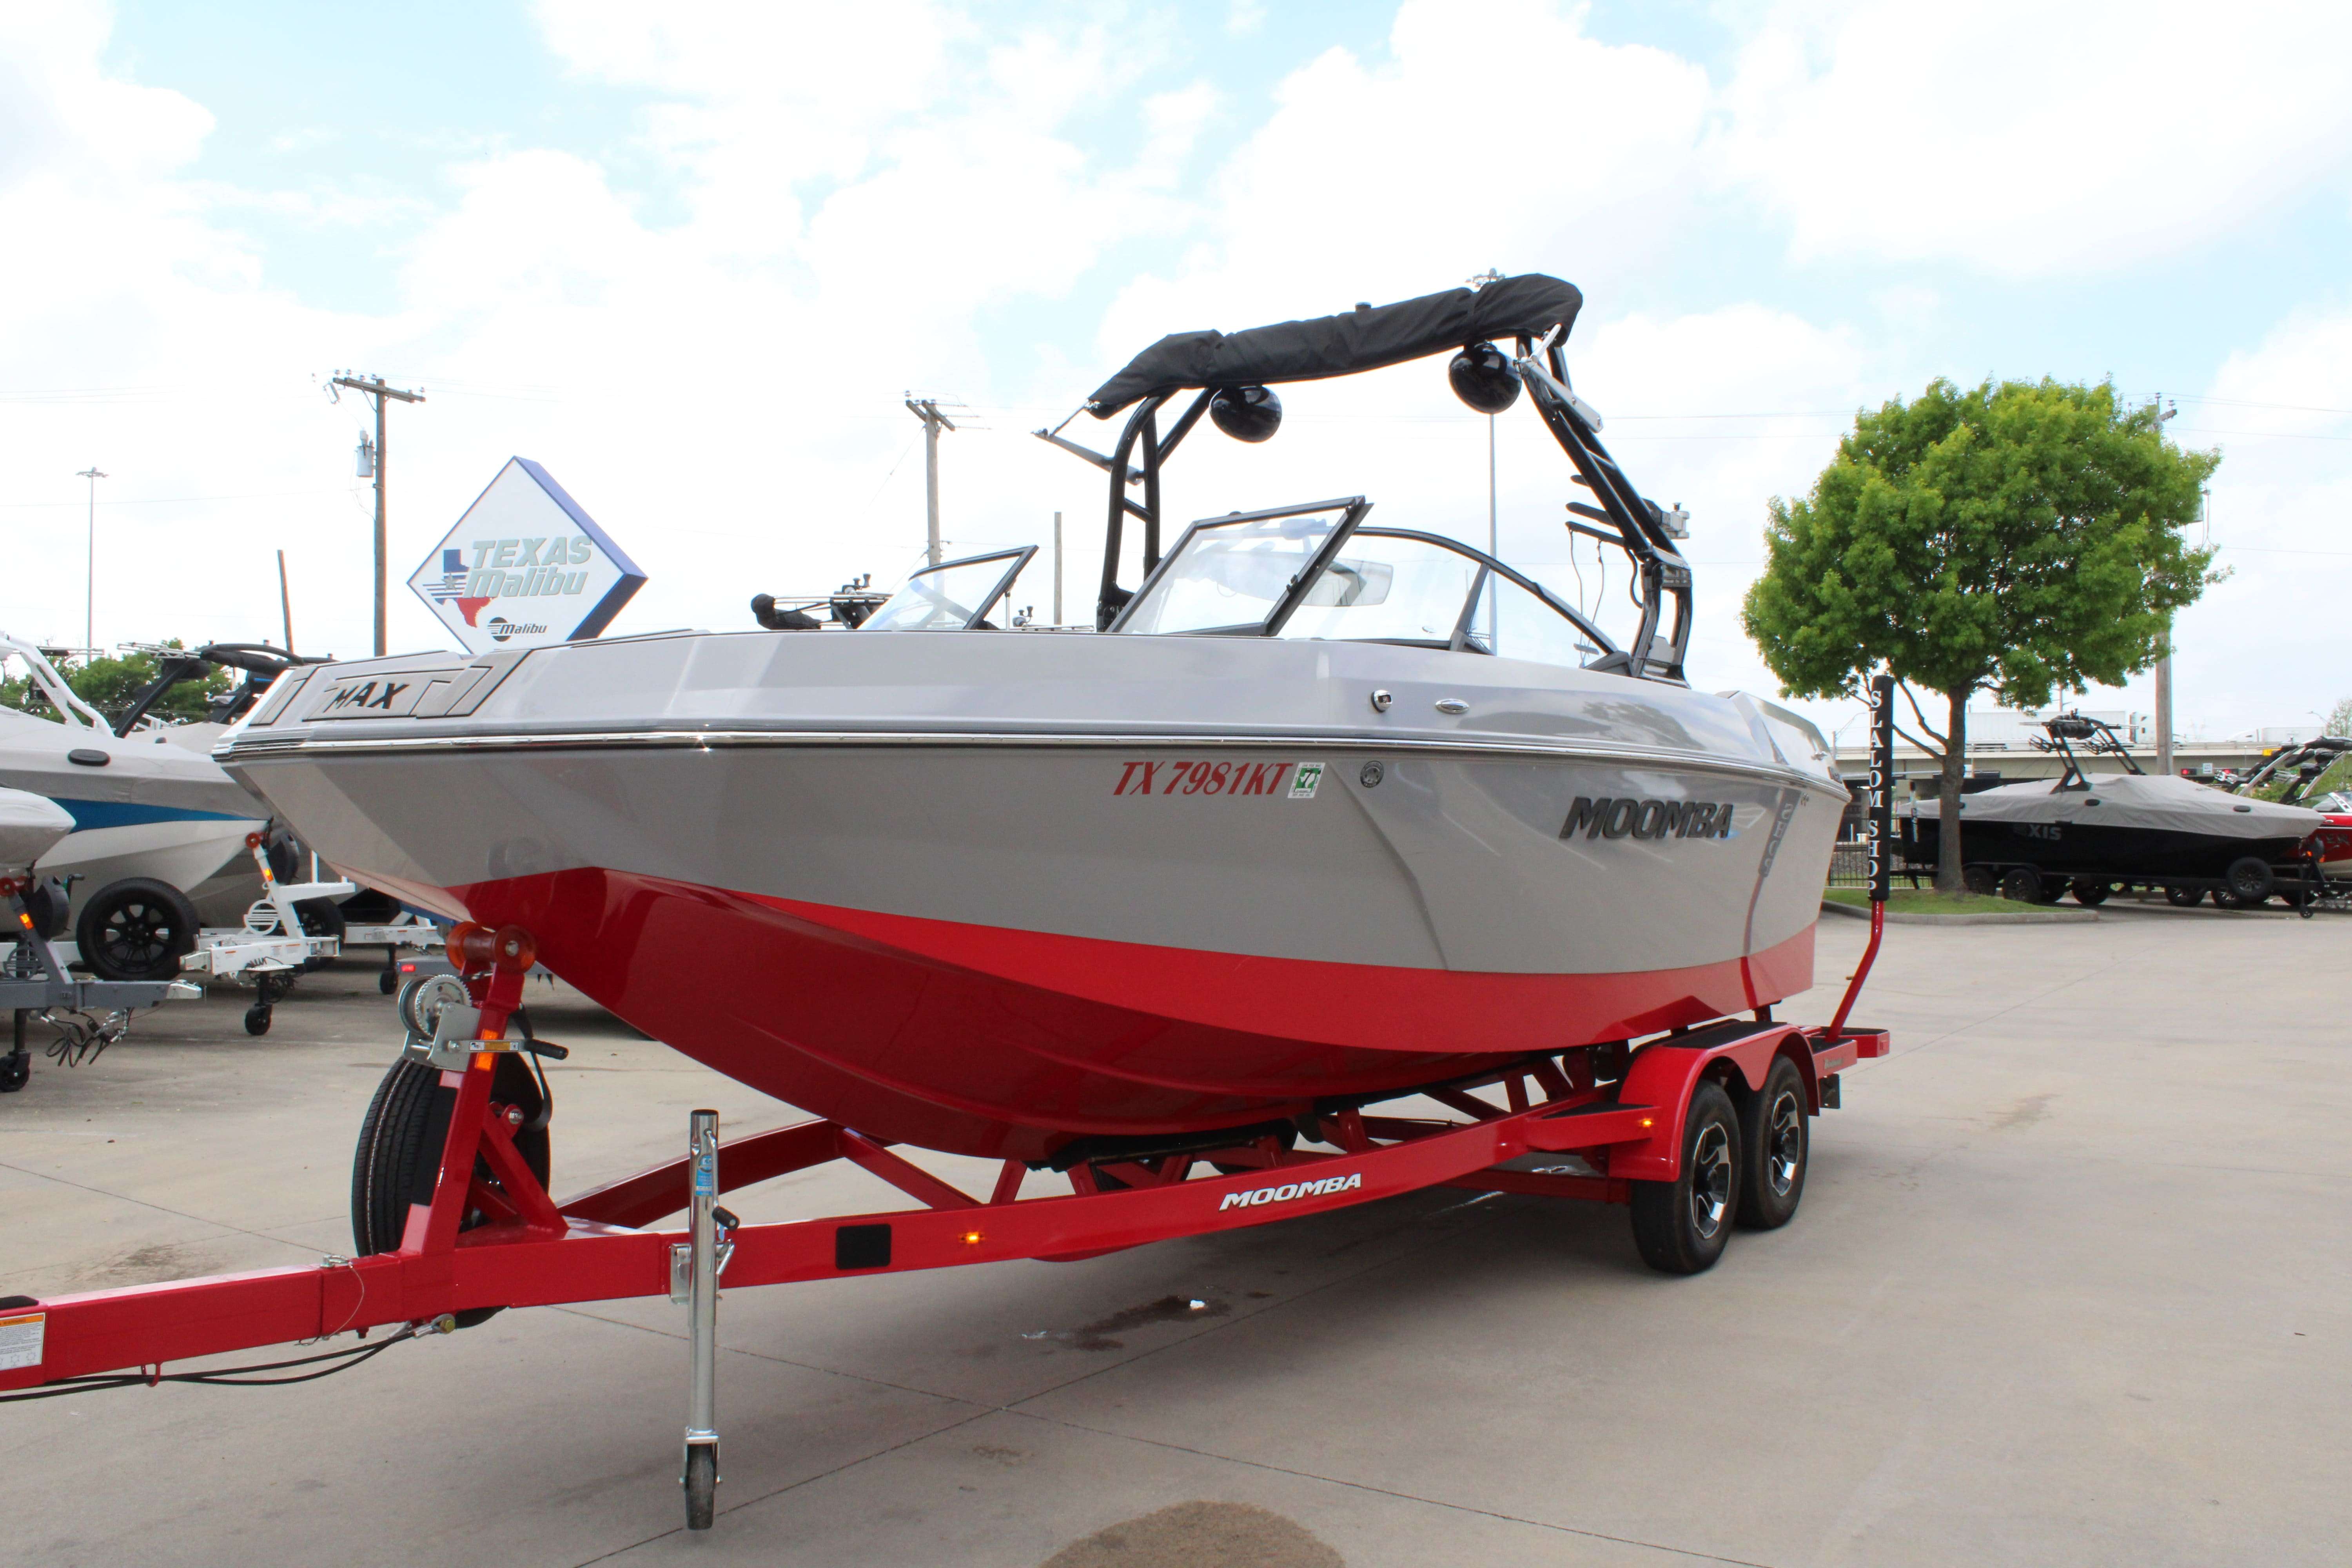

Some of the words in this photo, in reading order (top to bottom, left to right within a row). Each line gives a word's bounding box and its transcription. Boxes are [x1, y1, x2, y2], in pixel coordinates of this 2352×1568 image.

[472, 535, 592, 569] TEXAS
[323, 682, 410, 713] MAX
[1869, 690, 1883, 808] SLALOM
[1113, 761, 1165, 795] TX
[1163, 761, 1294, 795] 7981KT
[1558, 796, 1734, 839] MOOMBA
[1867, 819, 1880, 898] SHOP
[1219, 1173, 1362, 1211] MOOMBA
